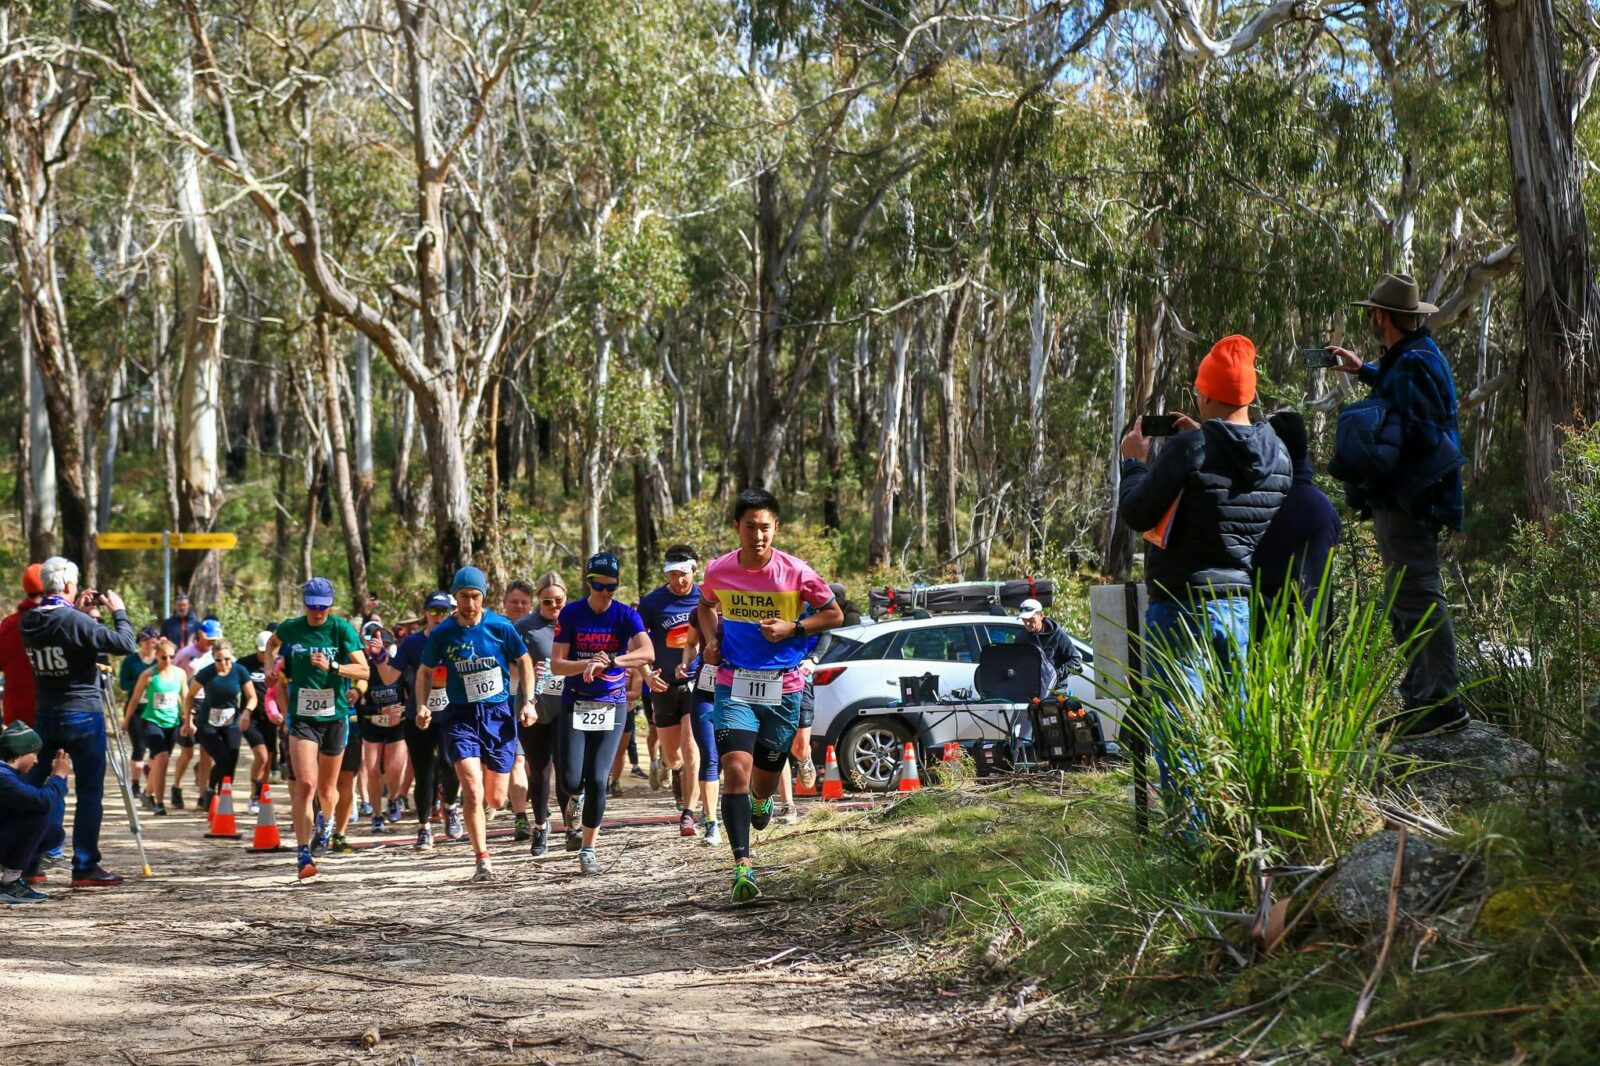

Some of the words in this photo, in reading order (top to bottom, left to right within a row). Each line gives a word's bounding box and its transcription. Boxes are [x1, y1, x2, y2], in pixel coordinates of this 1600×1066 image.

[731, 594, 775, 607] ULTRA
[728, 607, 781, 619] MEDIOCRE
[576, 632, 618, 642] CAPITAL
[476, 680, 495, 694] 102
[749, 682, 767, 697] 111
[305, 700, 328, 711] 204
[429, 697, 447, 707] 205
[582, 712, 606, 725] 229
